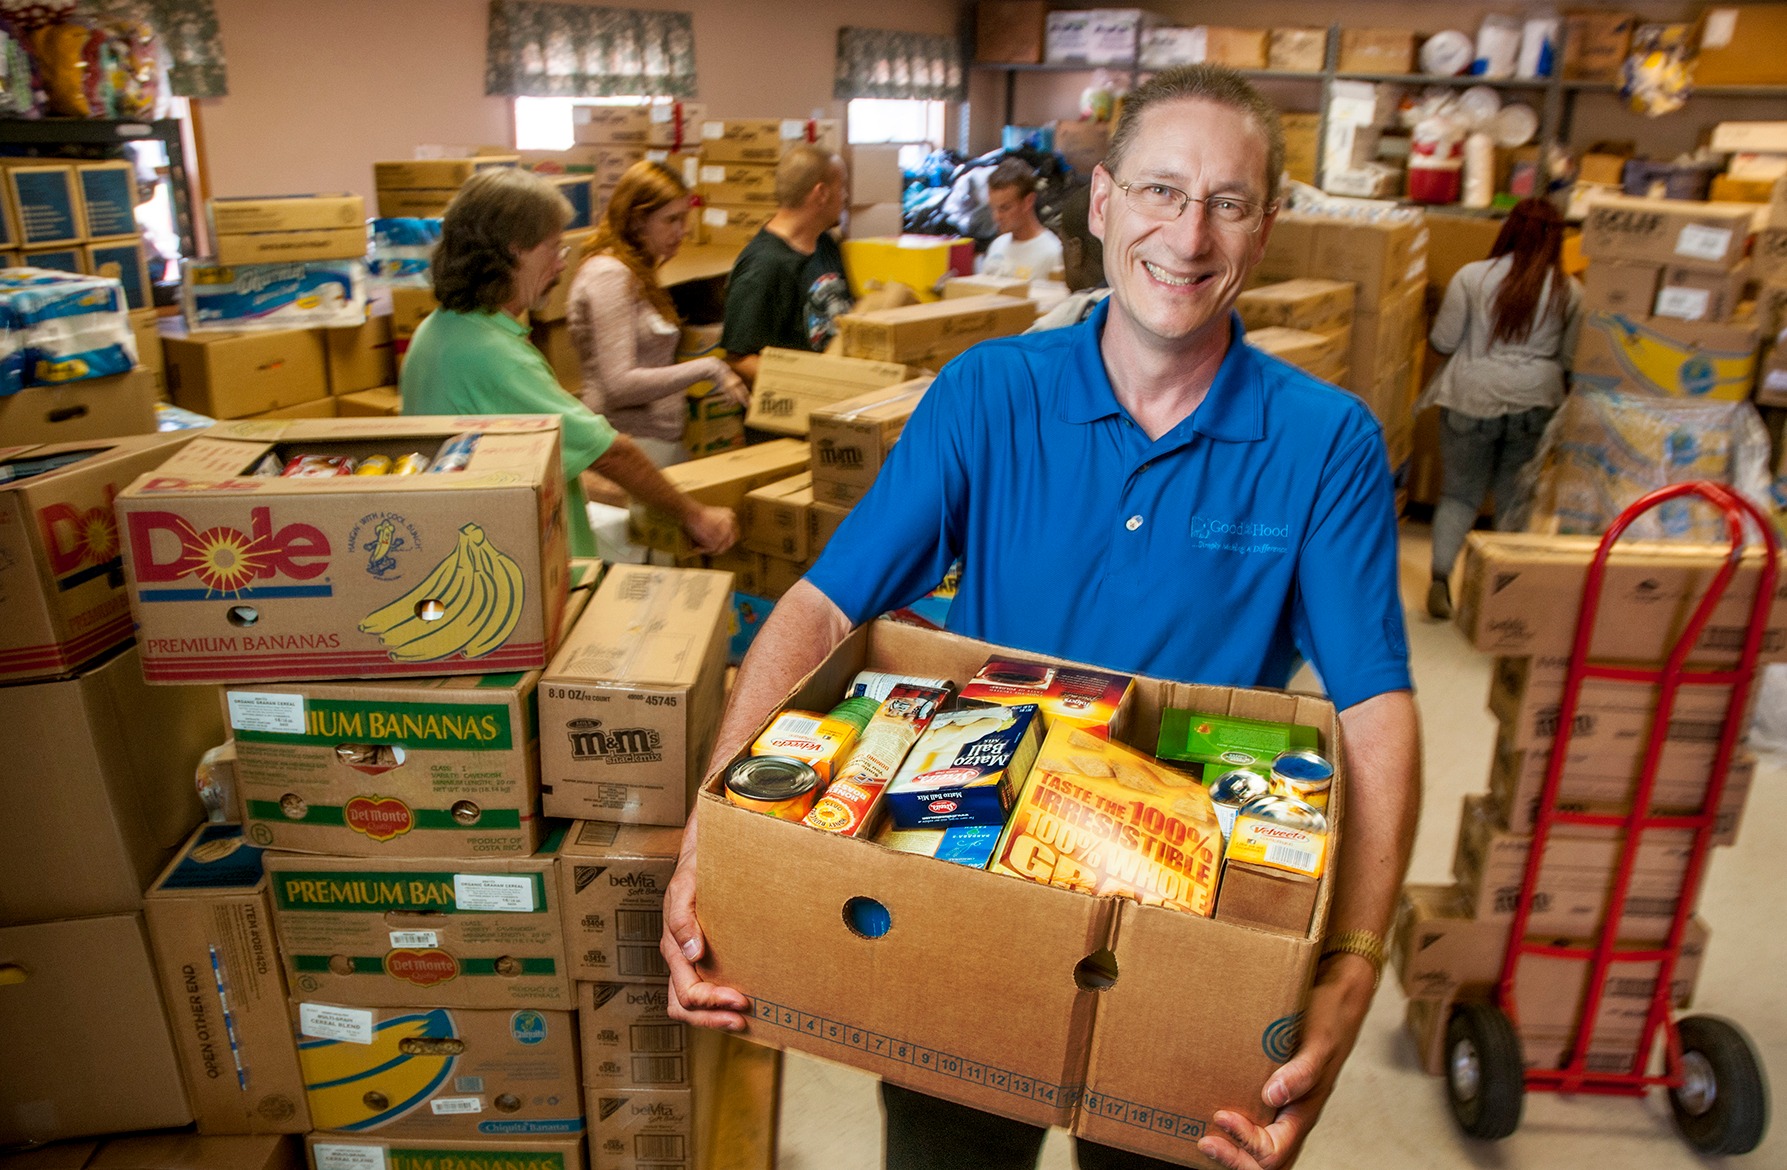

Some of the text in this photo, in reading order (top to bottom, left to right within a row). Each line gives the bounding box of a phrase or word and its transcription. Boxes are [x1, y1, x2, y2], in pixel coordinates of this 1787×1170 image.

[360, 512, 378, 525] WITH
[381, 511, 386, 519] A
[387, 512, 406, 526] COOL
[37, 483, 120, 577] Dol
[1210, 519, 1244, 536] Good
[1252, 523, 1289, 538] Hood
[126, 506, 332, 592] Dole
[1253, 543, 1288, 554] Difference
[147, 633, 341, 654] PREMIUM BANANAS
[548, 688, 565, 699] 8.0
[370, 711, 497, 741] BANANAS
[571, 728, 660, 756] m&m's
[772, 738, 822, 752] Velveeta
[968, 743, 1007, 757] Ball
[954, 754, 1010, 766] Matzo
[830, 782, 867, 800] ROAST
[930, 792, 943, 800] Ball
[943, 791, 963, 799] Matzo
[350, 809, 408, 823] Del Monte
[1041, 771, 1213, 865] TASTE THE 100%
[510, 836, 523, 844] OF
[1030, 785, 1211, 889] IRRESISTIBLE
[1254, 826, 1306, 840] Velveeta
[1025, 809, 1208, 917] 100% WHOLE
[609, 871, 656, 888] belVita
[285, 880, 404, 905] PREMIUM
[627, 888, 645, 897] Soft
[244, 904, 258, 929] ITEM
[392, 960, 453, 971] Del Monte
[626, 990, 668, 1005] belVita
[182, 965, 219, 1080] OPEN OTHER END
[762, 1006, 771, 1018] 2
[784, 1013, 793, 1025] 3
[806, 1019, 815, 1031] 4
[828, 1026, 838, 1038] 5
[851, 1032, 861, 1044] 6
[874, 1039, 884, 1050] 7
[897, 1046, 907, 1058] 8
[920, 1052, 931, 1065] 9
[941, 1058, 958, 1073] 10
[966, 1065, 982, 1080] 11
[989, 1071, 1006, 1087] 12
[1012, 1078, 1030, 1094] 13
[1037, 1085, 1054, 1101] 14
[1083, 1093, 1098, 1109] 16
[1105, 1101, 1124, 1116] 17
[1130, 1108, 1149, 1123] 18
[1156, 1115, 1174, 1131] 19
[1180, 1122, 1200, 1137] 20
[631, 1102, 673, 1117] belVita
[486, 1123, 526, 1133] Chiquita
